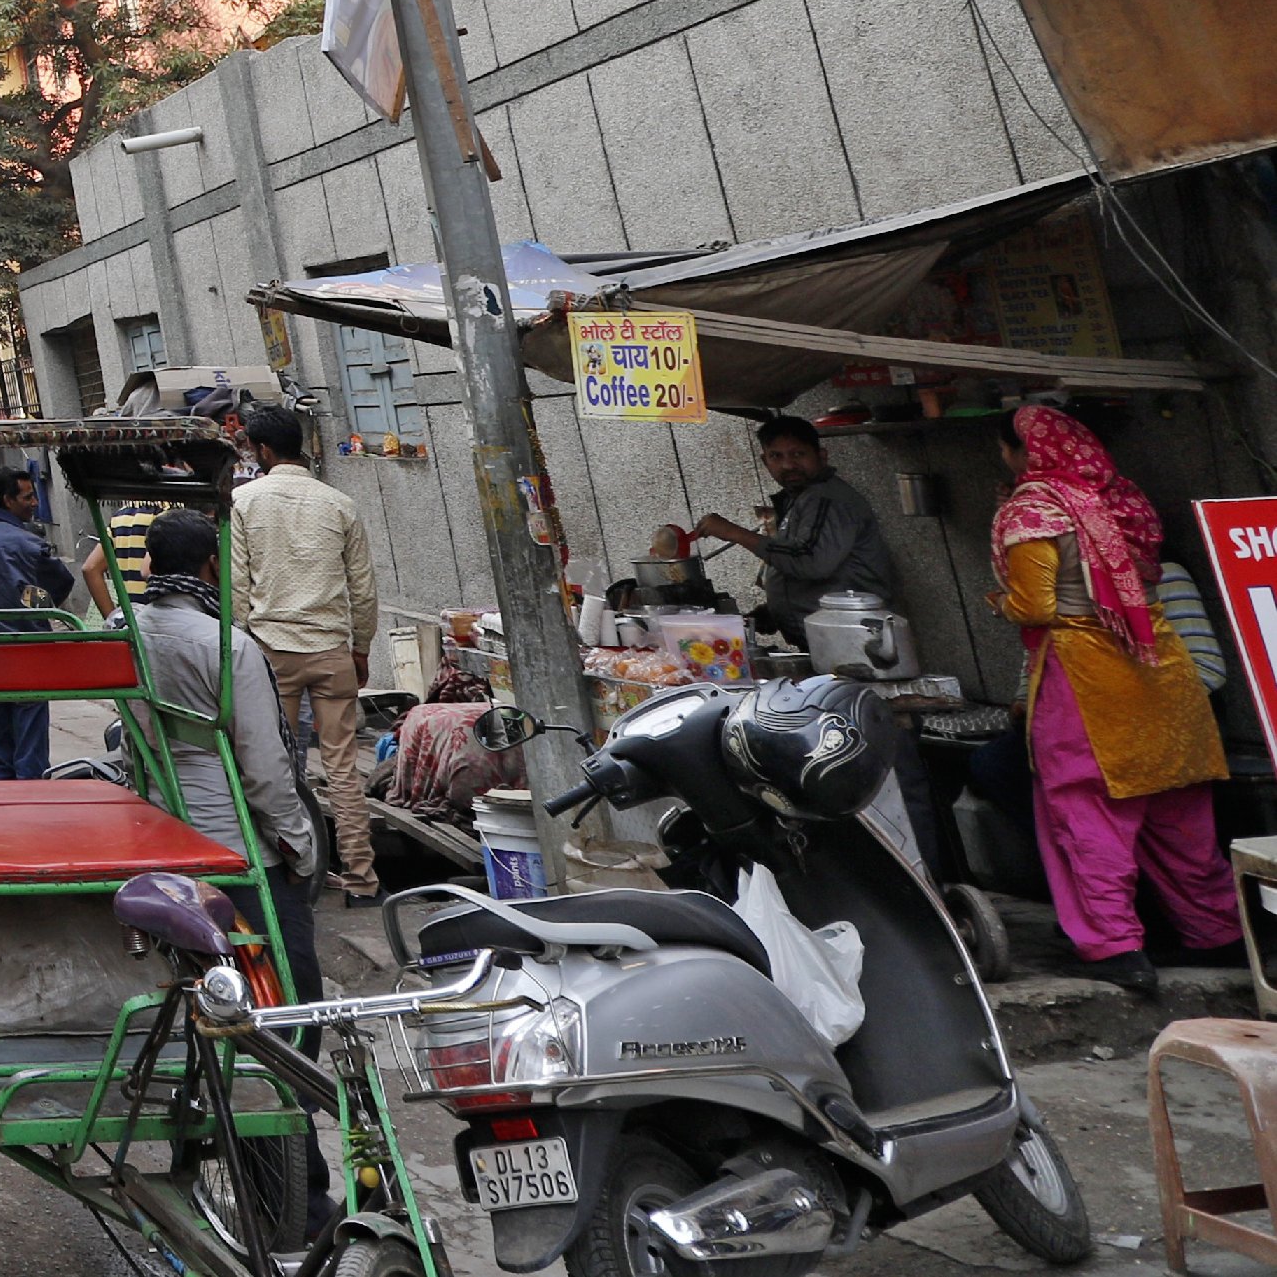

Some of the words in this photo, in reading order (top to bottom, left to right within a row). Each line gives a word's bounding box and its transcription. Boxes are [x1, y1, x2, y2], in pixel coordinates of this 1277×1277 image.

[580, 319, 616, 341] भोले
[618, 318, 636, 340] टी
[639, 319, 684, 341] स्टॉल
[610, 345, 649, 369] चाय
[650, 346, 690, 371] 10/-
[586, 375, 651, 407] Coffee
[654, 383, 694, 409] 20/-
[1229, 526, 1277, 562] SH
[487, 1170, 571, 1205] SV7506
